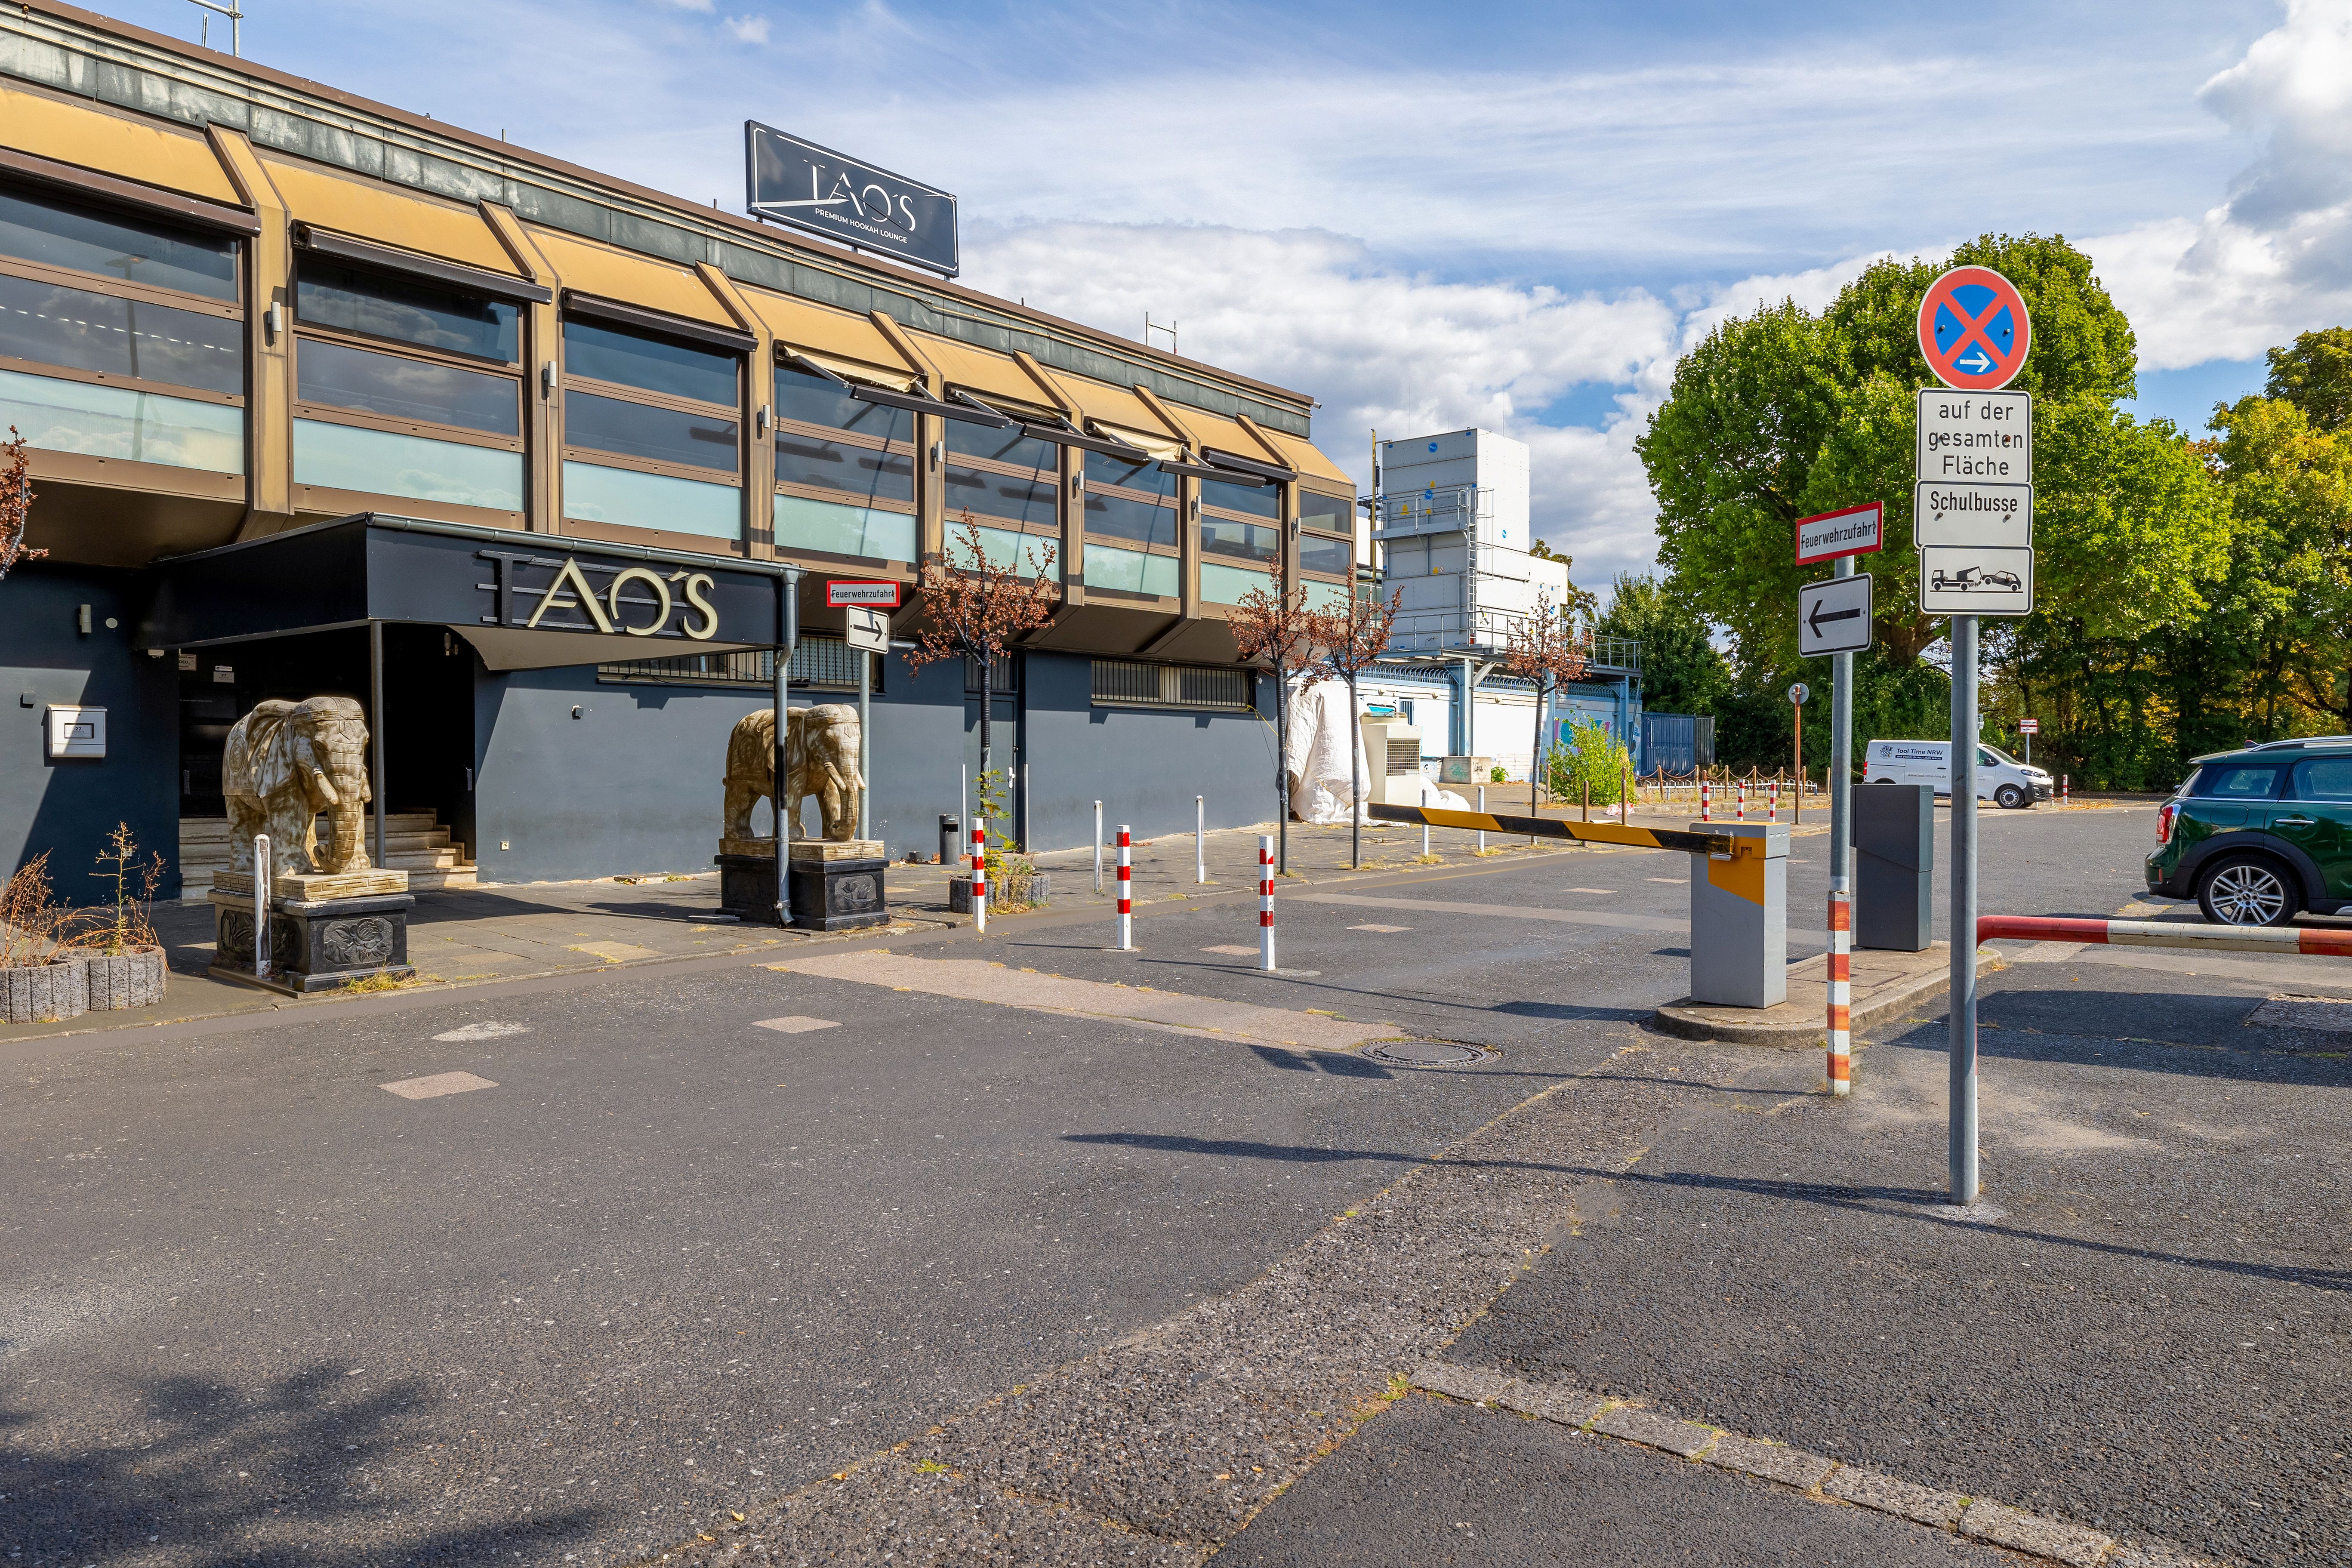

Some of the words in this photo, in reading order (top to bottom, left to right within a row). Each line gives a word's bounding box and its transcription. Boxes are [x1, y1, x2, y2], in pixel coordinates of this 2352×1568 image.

[815, 208, 848, 224] PREMIUM
[850, 219, 879, 234] HOOKAH
[880, 229, 908, 243] LOUNGE
[1939, 400, 1970, 419] auf
[1981, 401, 2014, 420] der
[1929, 430, 2022, 451] gesamten
[1943, 455, 2009, 475] Fläche
[1930, 491, 2017, 512] Schulbusse
[1801, 521, 1876, 549] Feuerwehrzufahrt
[832, 589, 895, 598] Feuerwehrzufahrt
